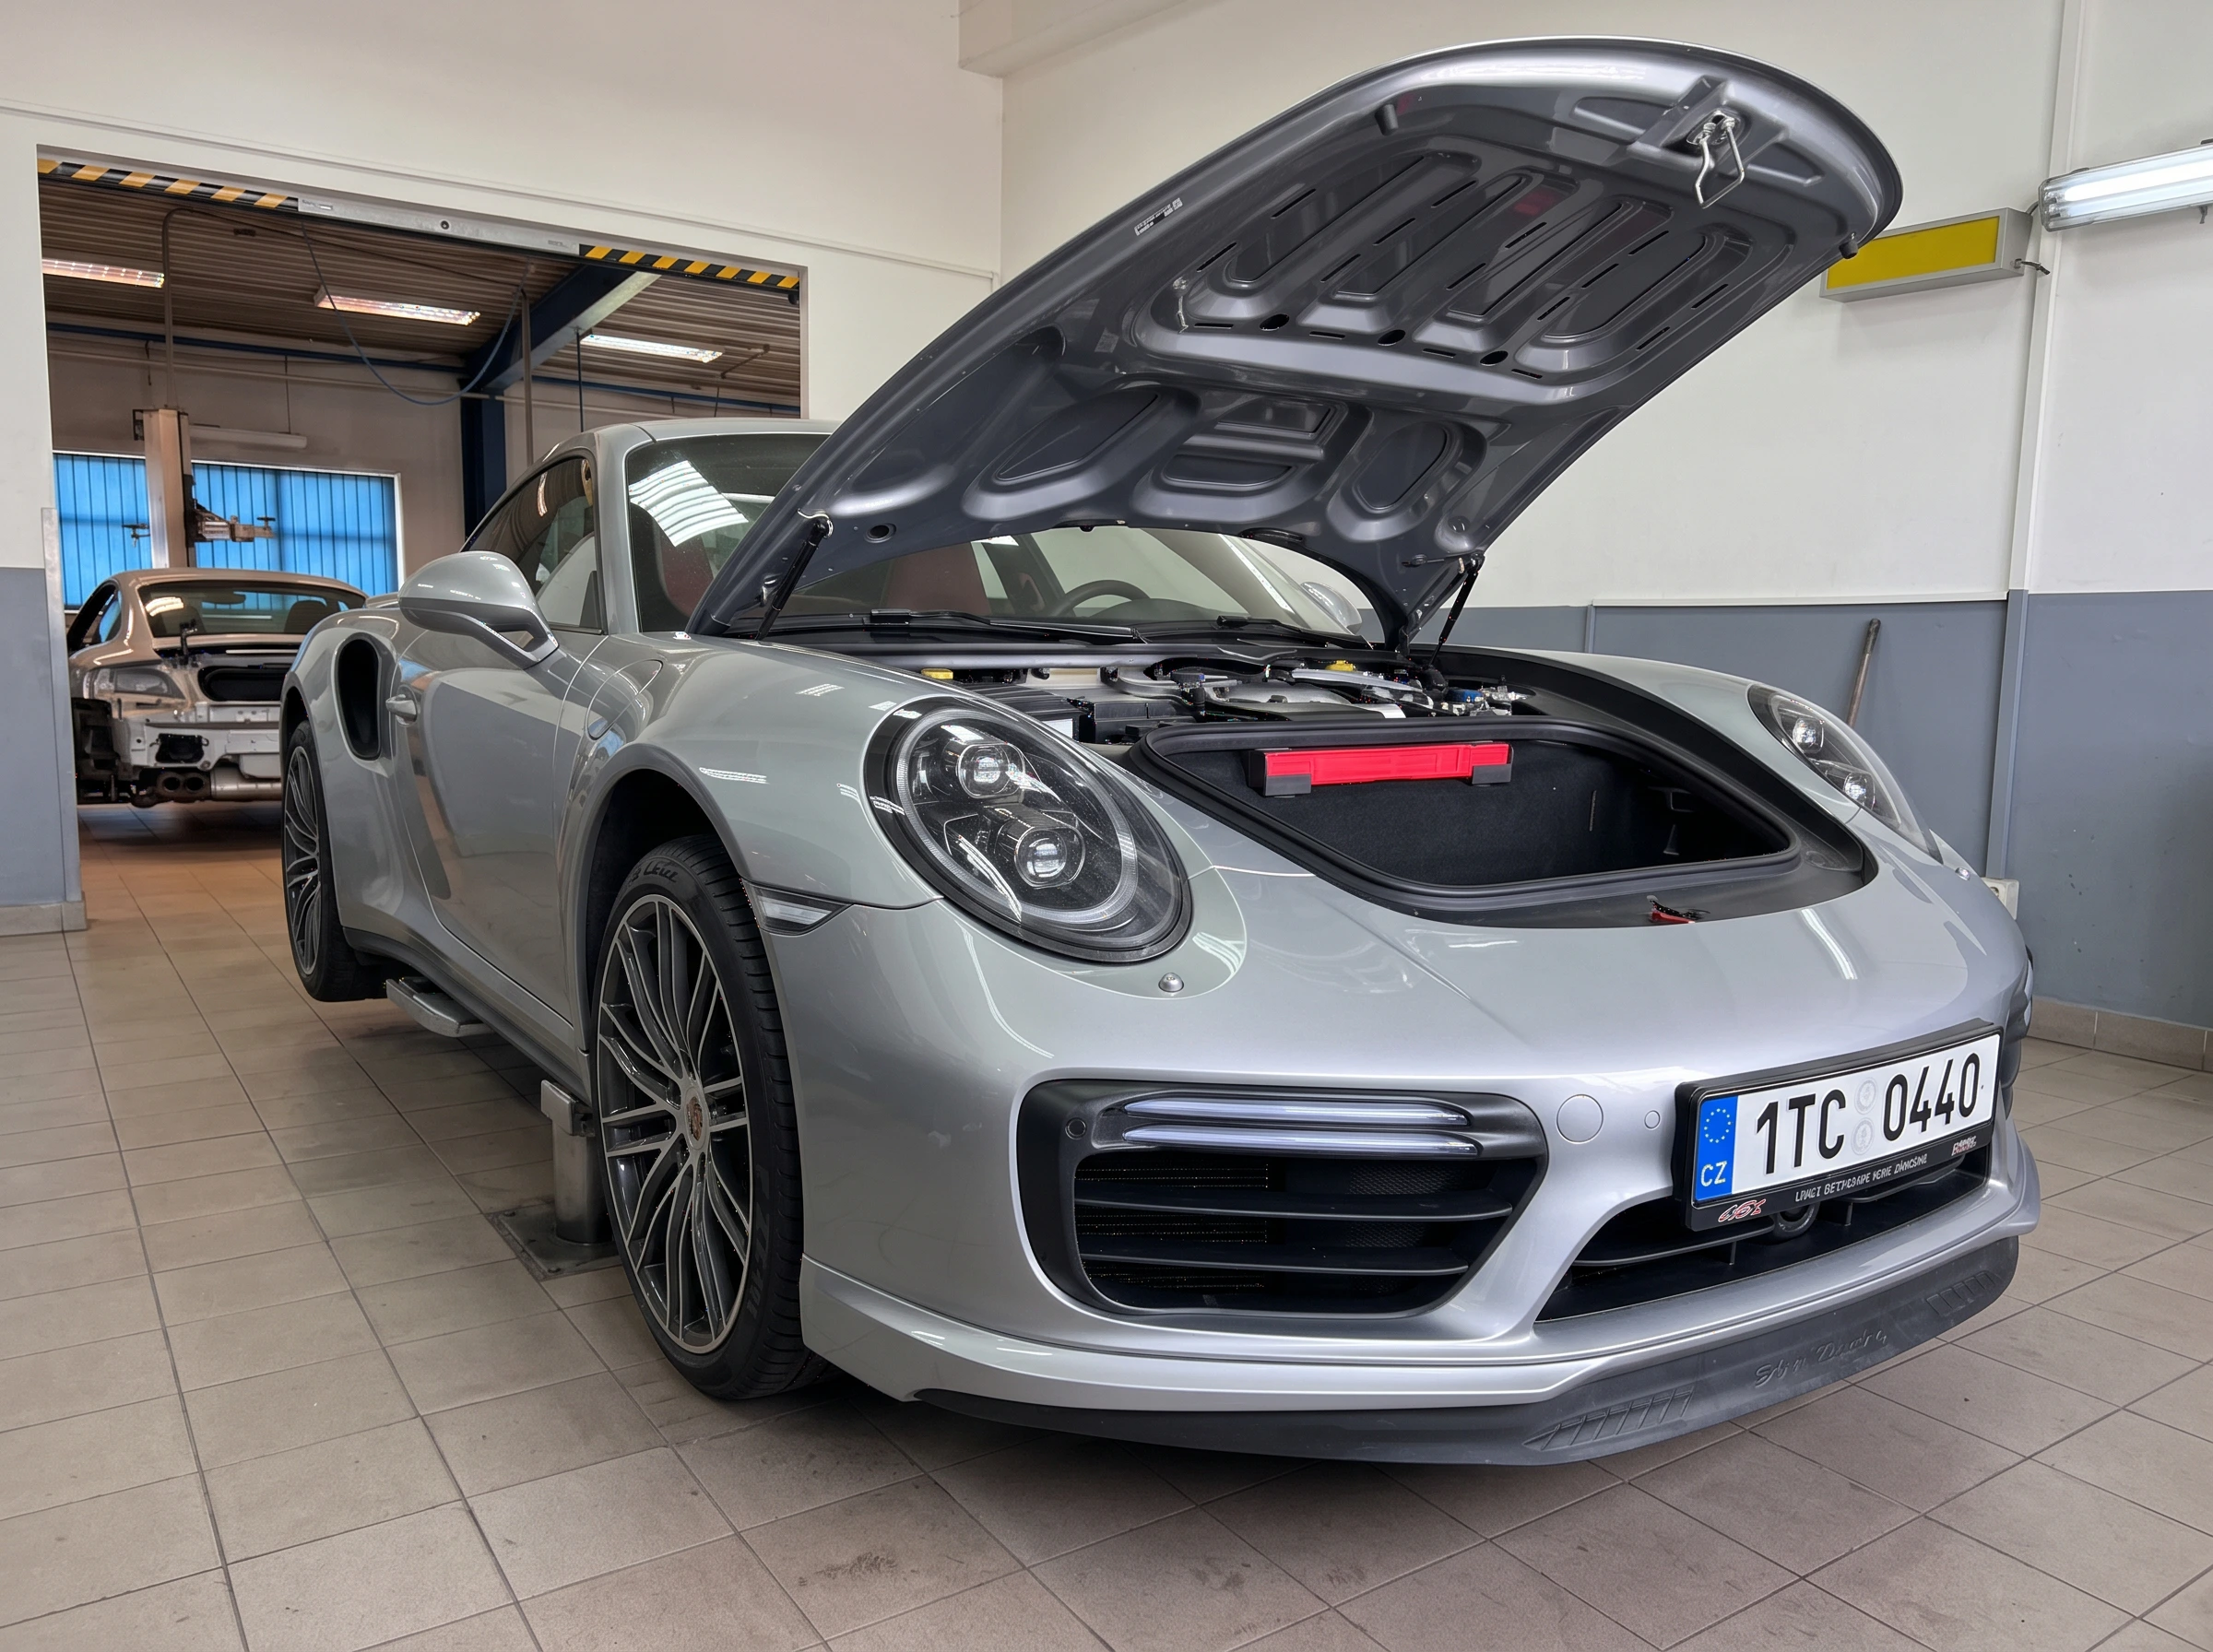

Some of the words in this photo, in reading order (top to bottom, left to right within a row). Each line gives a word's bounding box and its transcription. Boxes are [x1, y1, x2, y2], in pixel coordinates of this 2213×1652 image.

[1756, 1089, 1845, 1175] 1TC
[1883, 1052, 1981, 1141] 0440
[1700, 1161, 1728, 1187] CZ
